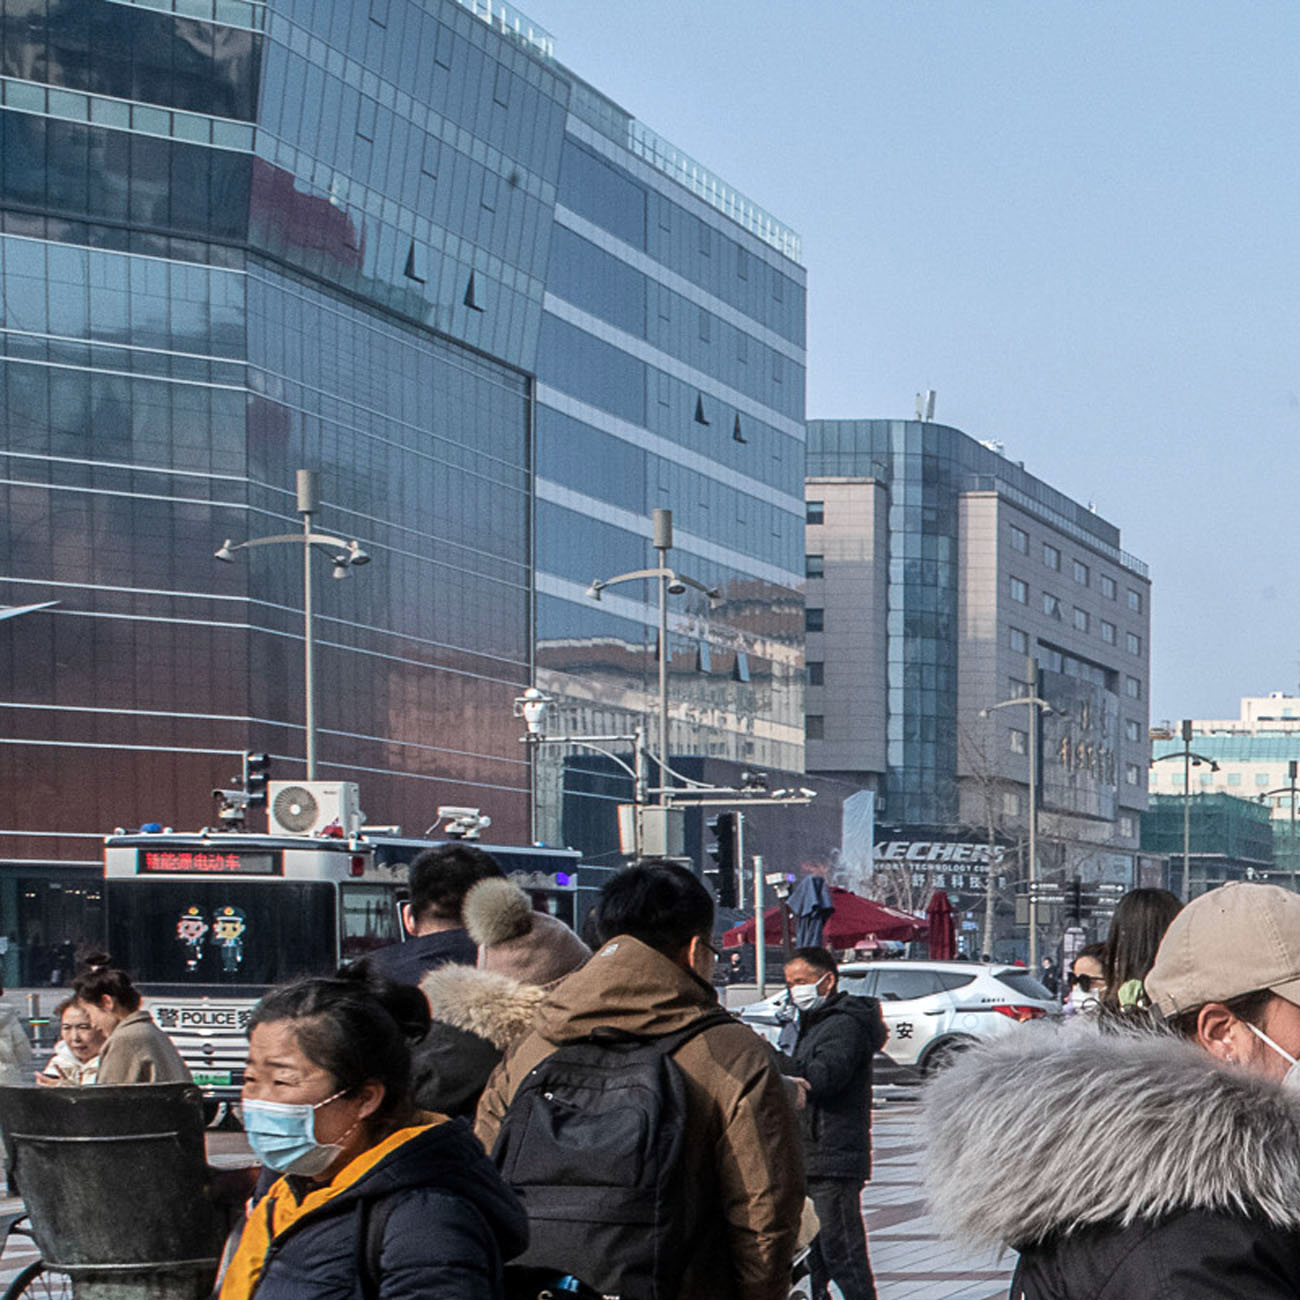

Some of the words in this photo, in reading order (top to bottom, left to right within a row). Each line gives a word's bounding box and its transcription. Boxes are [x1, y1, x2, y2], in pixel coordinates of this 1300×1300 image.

[909, 863, 971, 872] TECHNOLOGY
[181, 1012, 236, 1025] POLICE
[896, 1022, 914, 1040] 安
